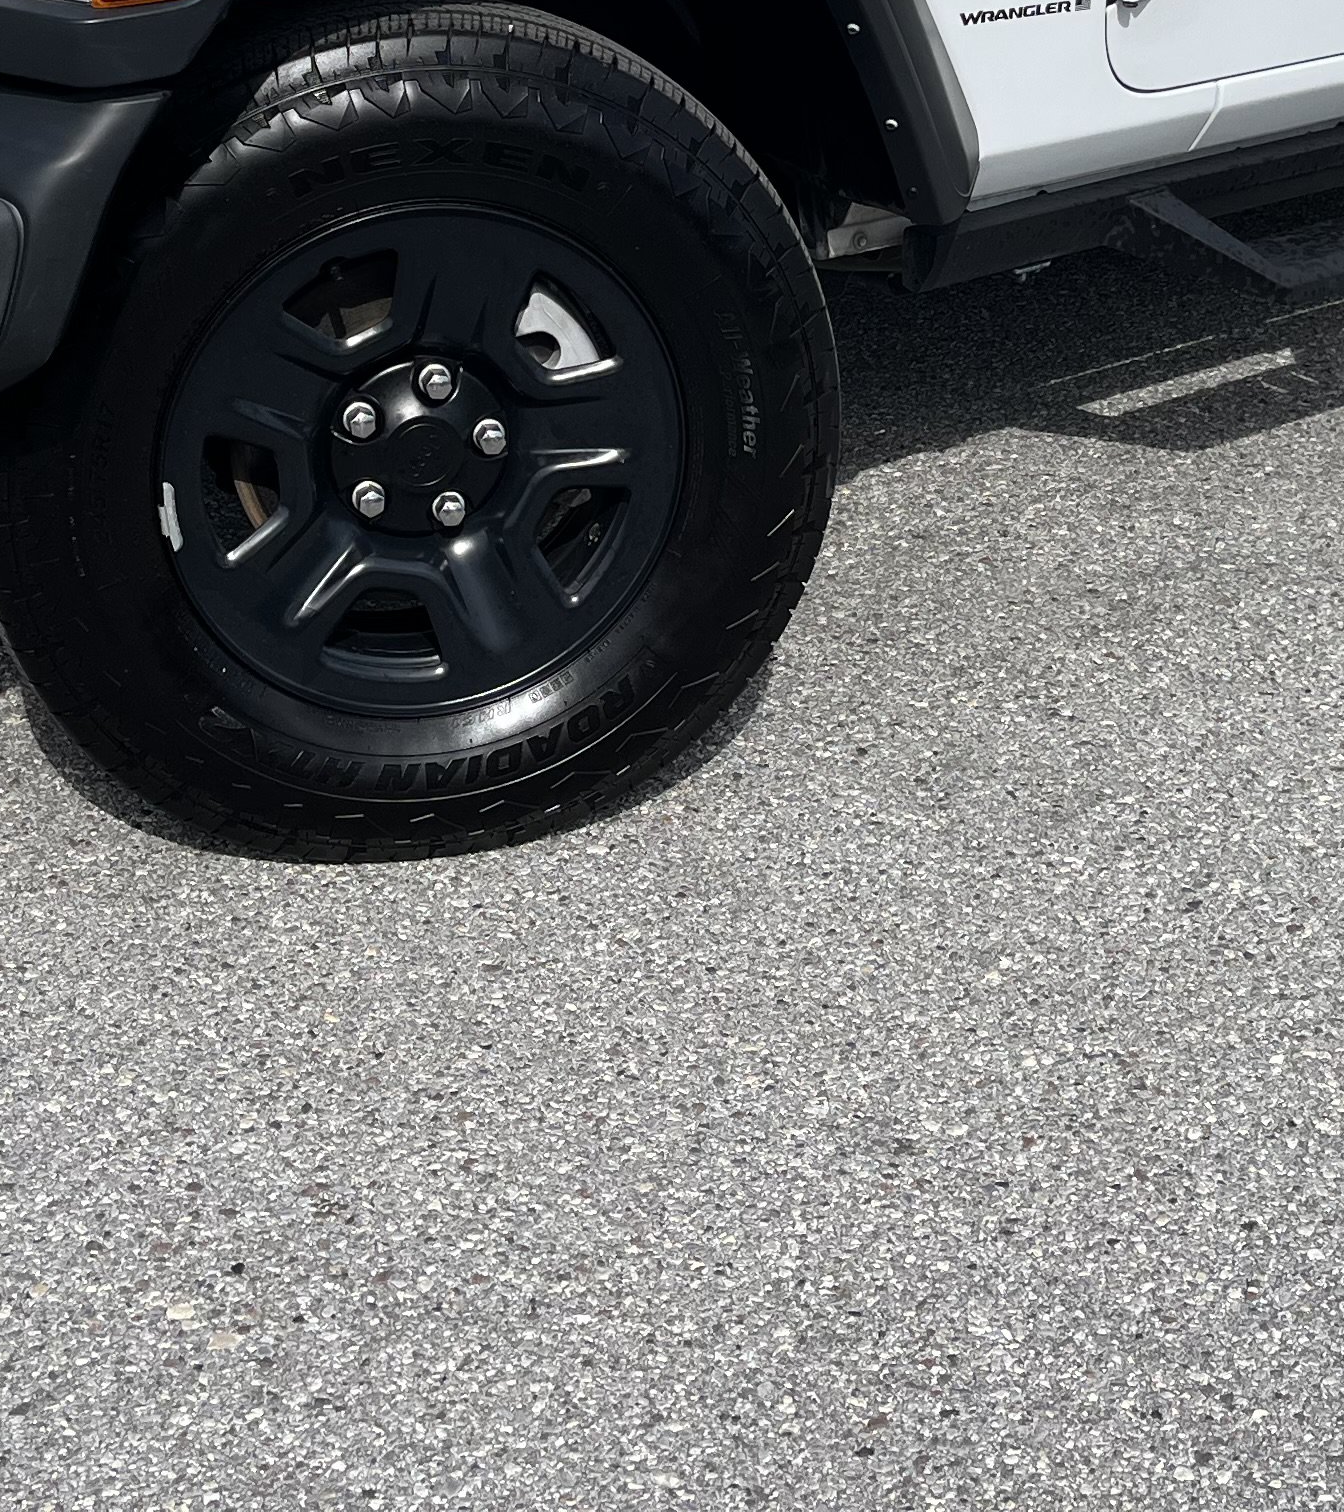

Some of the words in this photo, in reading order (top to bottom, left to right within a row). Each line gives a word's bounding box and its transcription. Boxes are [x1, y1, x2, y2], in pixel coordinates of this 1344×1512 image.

[959, 0, 1072, 27] WRANGLER
[287, 137, 592, 199] NEXEN
[374, 677, 640, 794] ROADIAN
